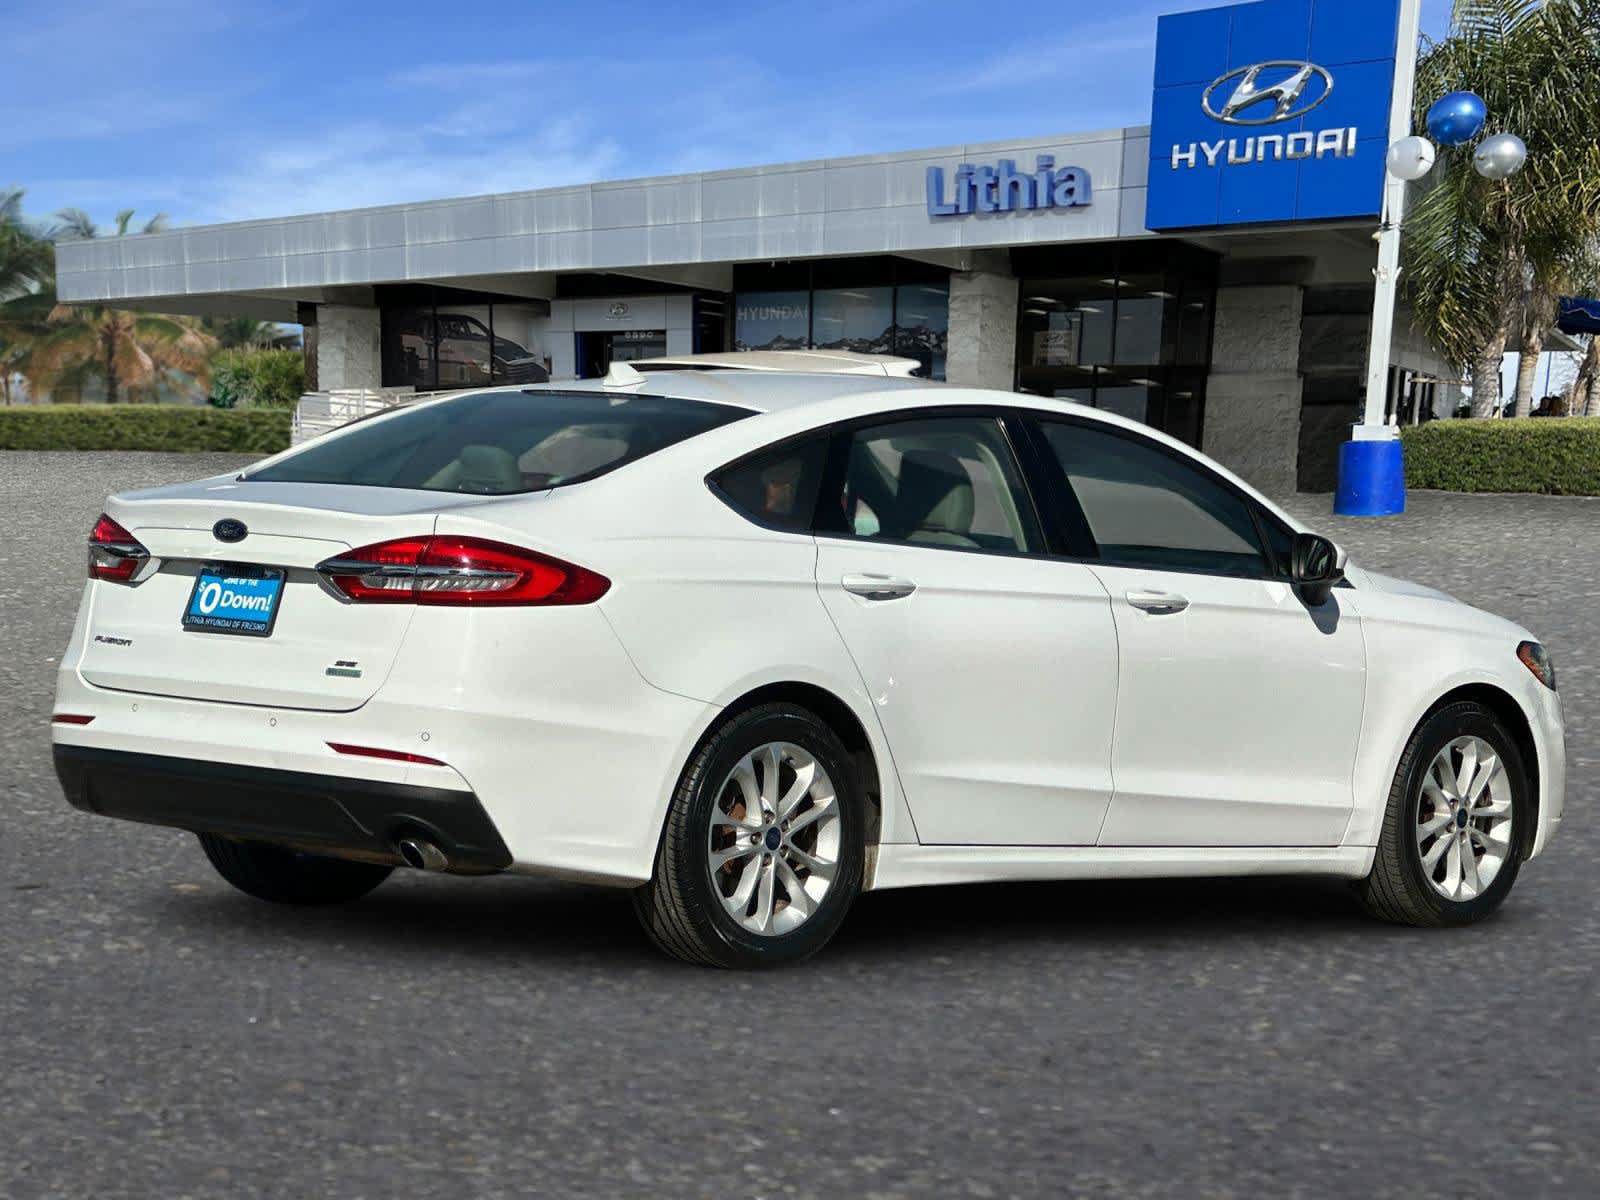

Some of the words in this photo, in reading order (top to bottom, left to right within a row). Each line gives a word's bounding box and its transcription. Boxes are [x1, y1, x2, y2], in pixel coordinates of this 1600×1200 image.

[1171, 127, 1358, 169] HYUNDAI
[926, 154, 1092, 216] Lithia
[736, 304, 808, 321] HYUNDAI
[220, 589, 272, 612] Down!
[205, 616, 231, 628] HYUNDAI
[231, 619, 240, 629] OF
[240, 621, 266, 632] FRESNO
